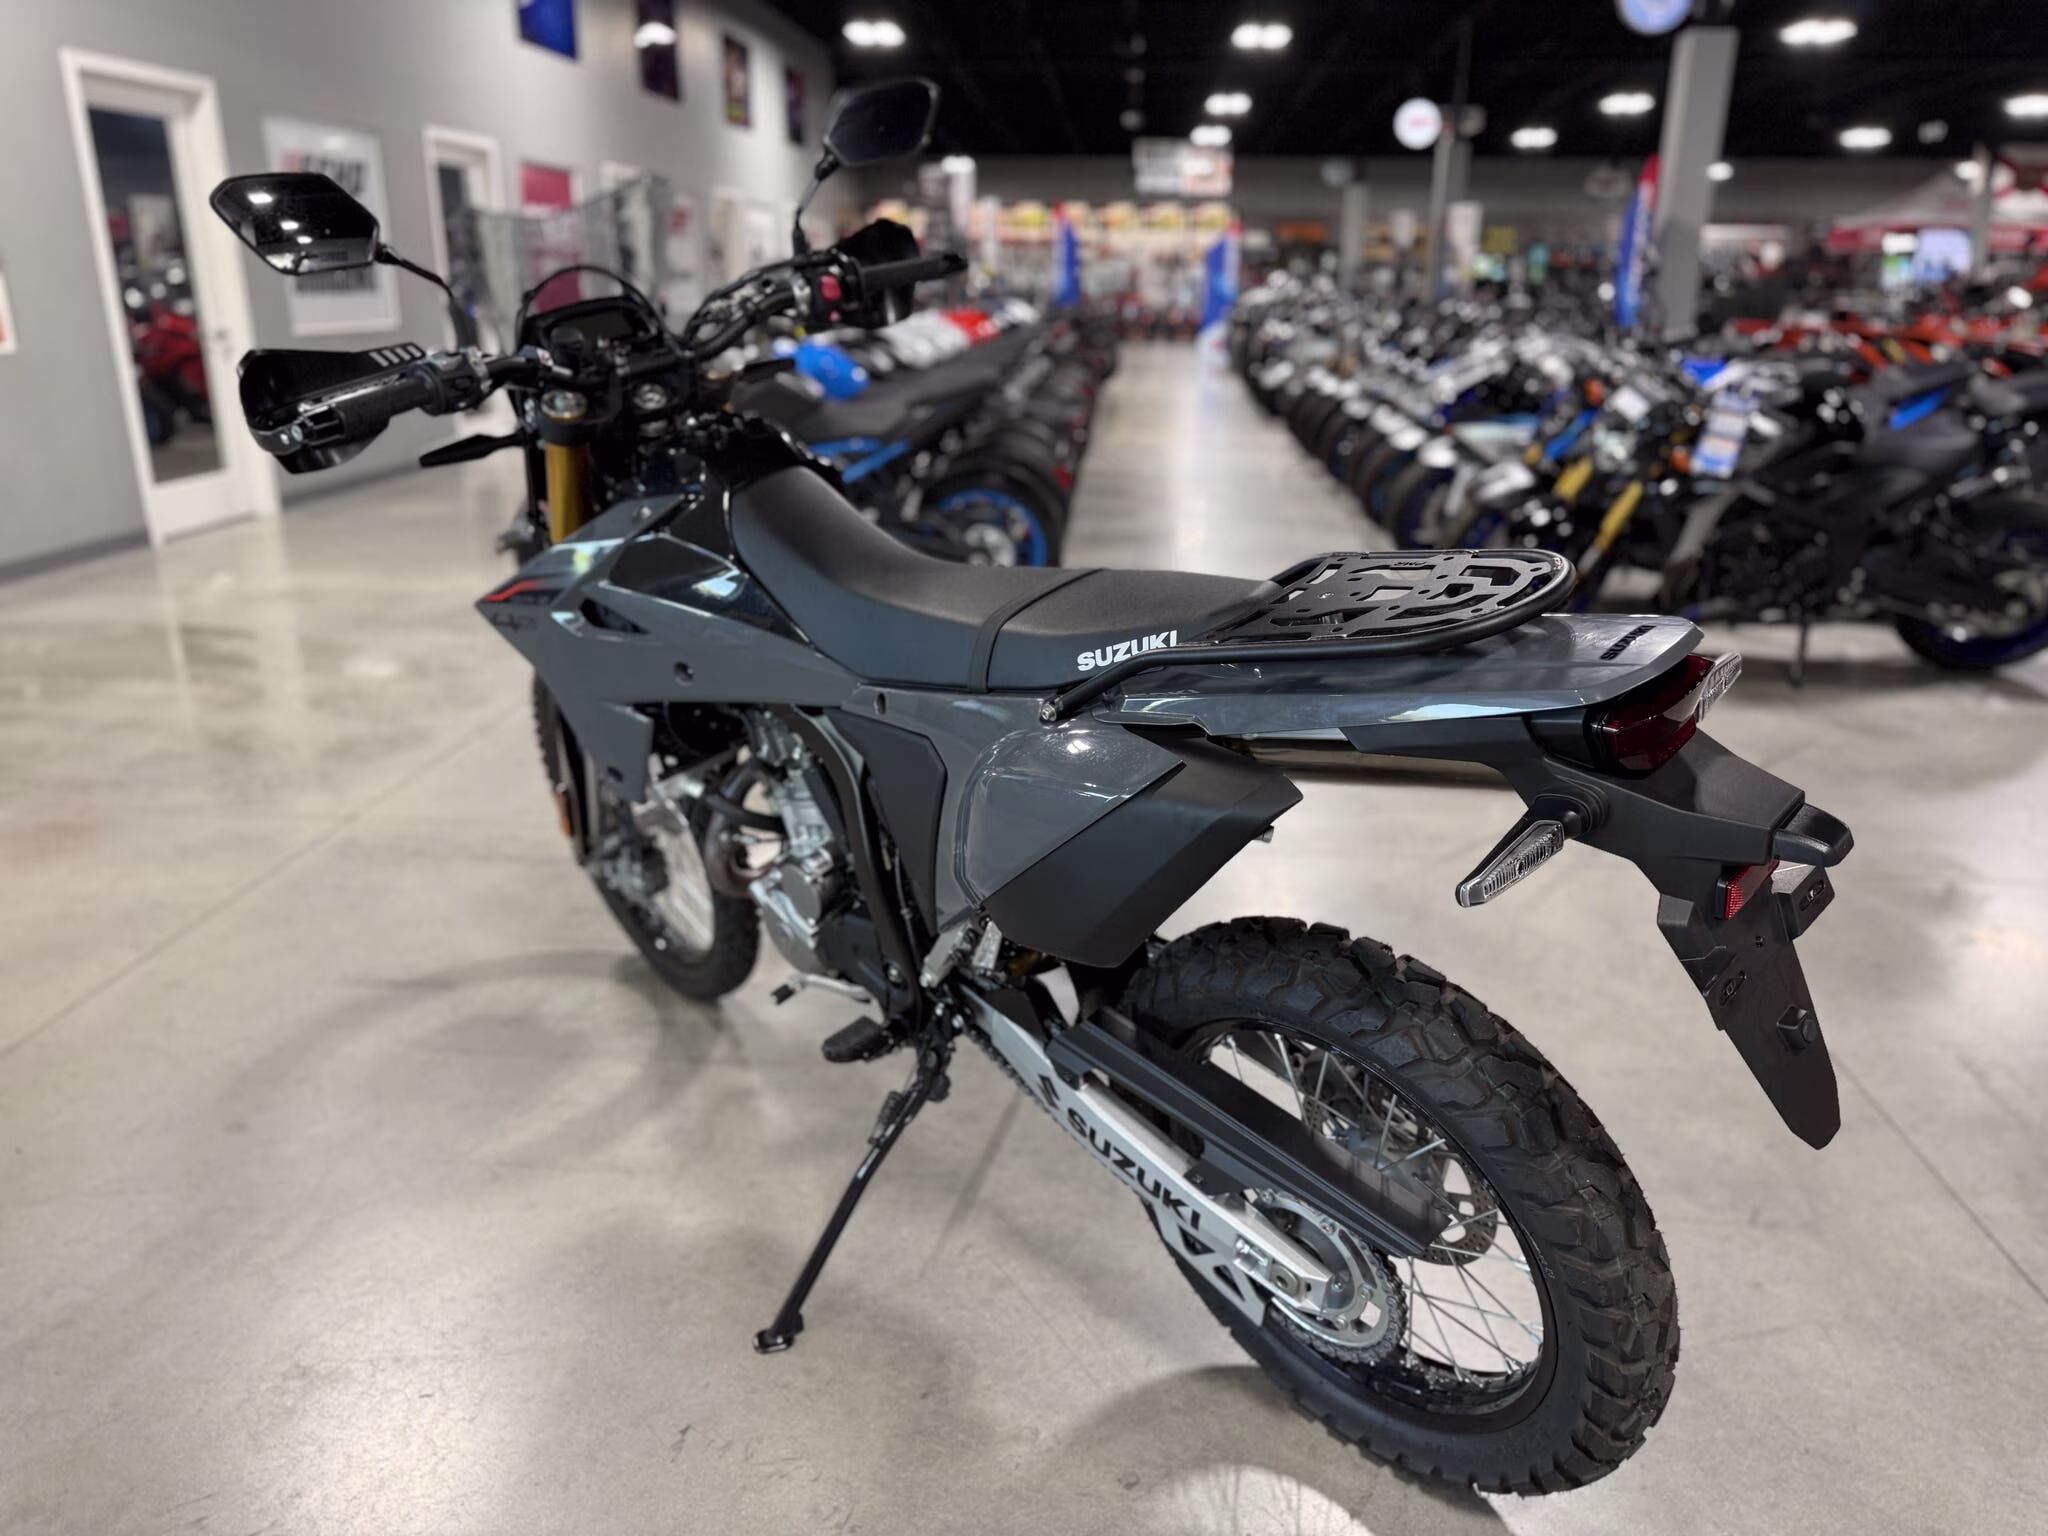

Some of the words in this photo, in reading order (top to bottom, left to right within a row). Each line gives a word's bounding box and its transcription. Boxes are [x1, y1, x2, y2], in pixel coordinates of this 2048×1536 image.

[1077, 630, 1177, 671] SUZUKI
[1599, 625, 1656, 660] SUZUKI
[1067, 1107, 1200, 1231] SUZUKI
